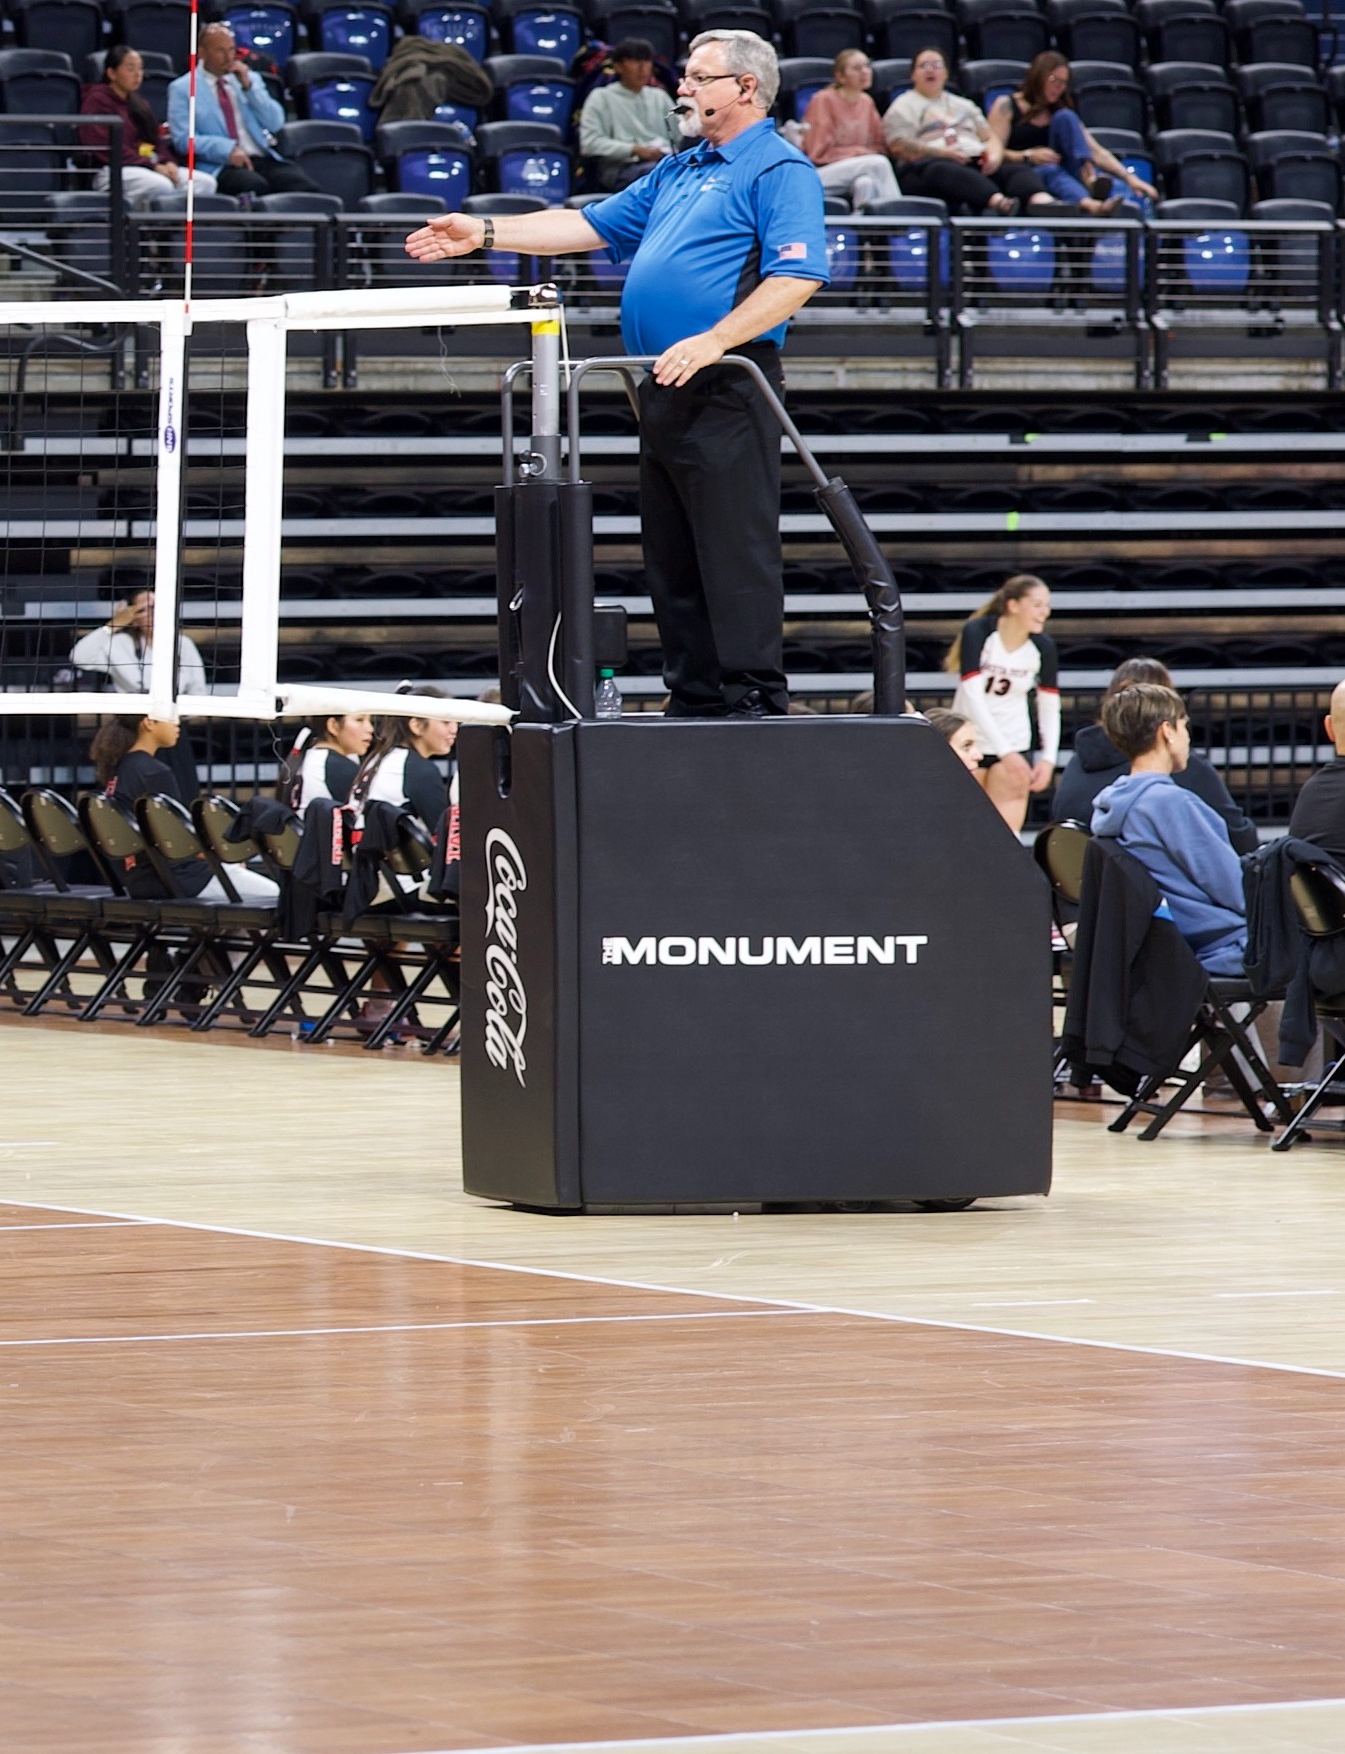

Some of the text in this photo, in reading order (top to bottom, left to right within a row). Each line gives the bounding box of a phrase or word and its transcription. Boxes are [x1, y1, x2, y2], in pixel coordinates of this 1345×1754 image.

[985, 676, 1011, 696] 13
[485, 827, 527, 1088] Coca-Cola
[602, 935, 928, 965] THE MONUMENT
